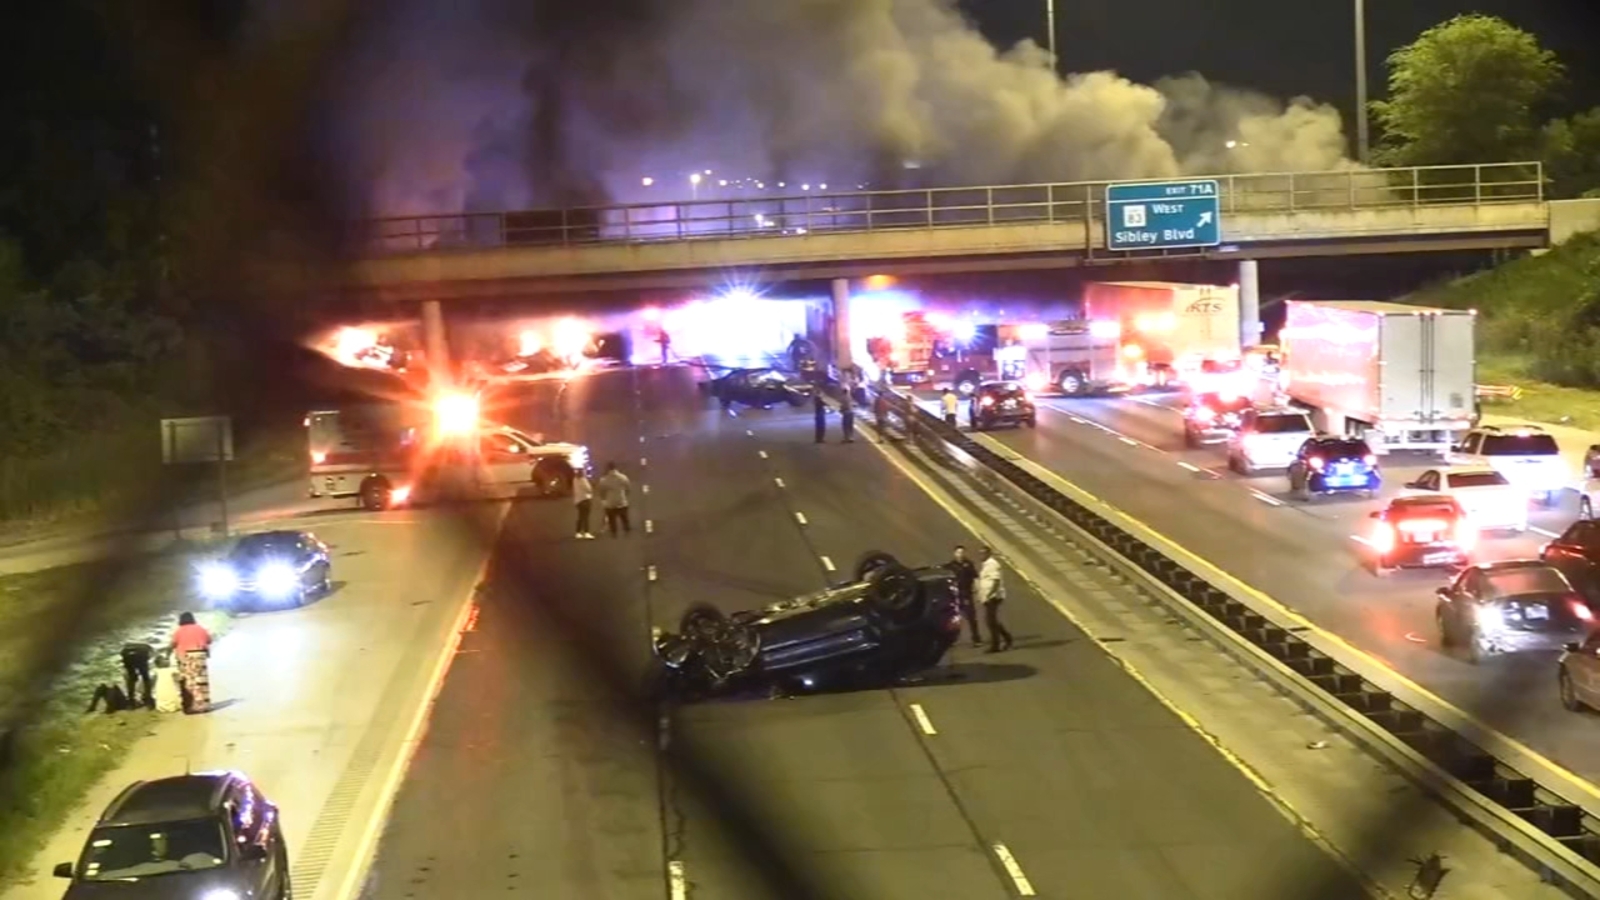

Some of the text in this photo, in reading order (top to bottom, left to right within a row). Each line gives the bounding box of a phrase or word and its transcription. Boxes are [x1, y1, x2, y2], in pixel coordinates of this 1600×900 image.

[1165, 184, 1213, 195] EXIT 71A
[1152, 204, 1184, 214] WEST
[1115, 228, 1195, 244] Sibley Blvd
